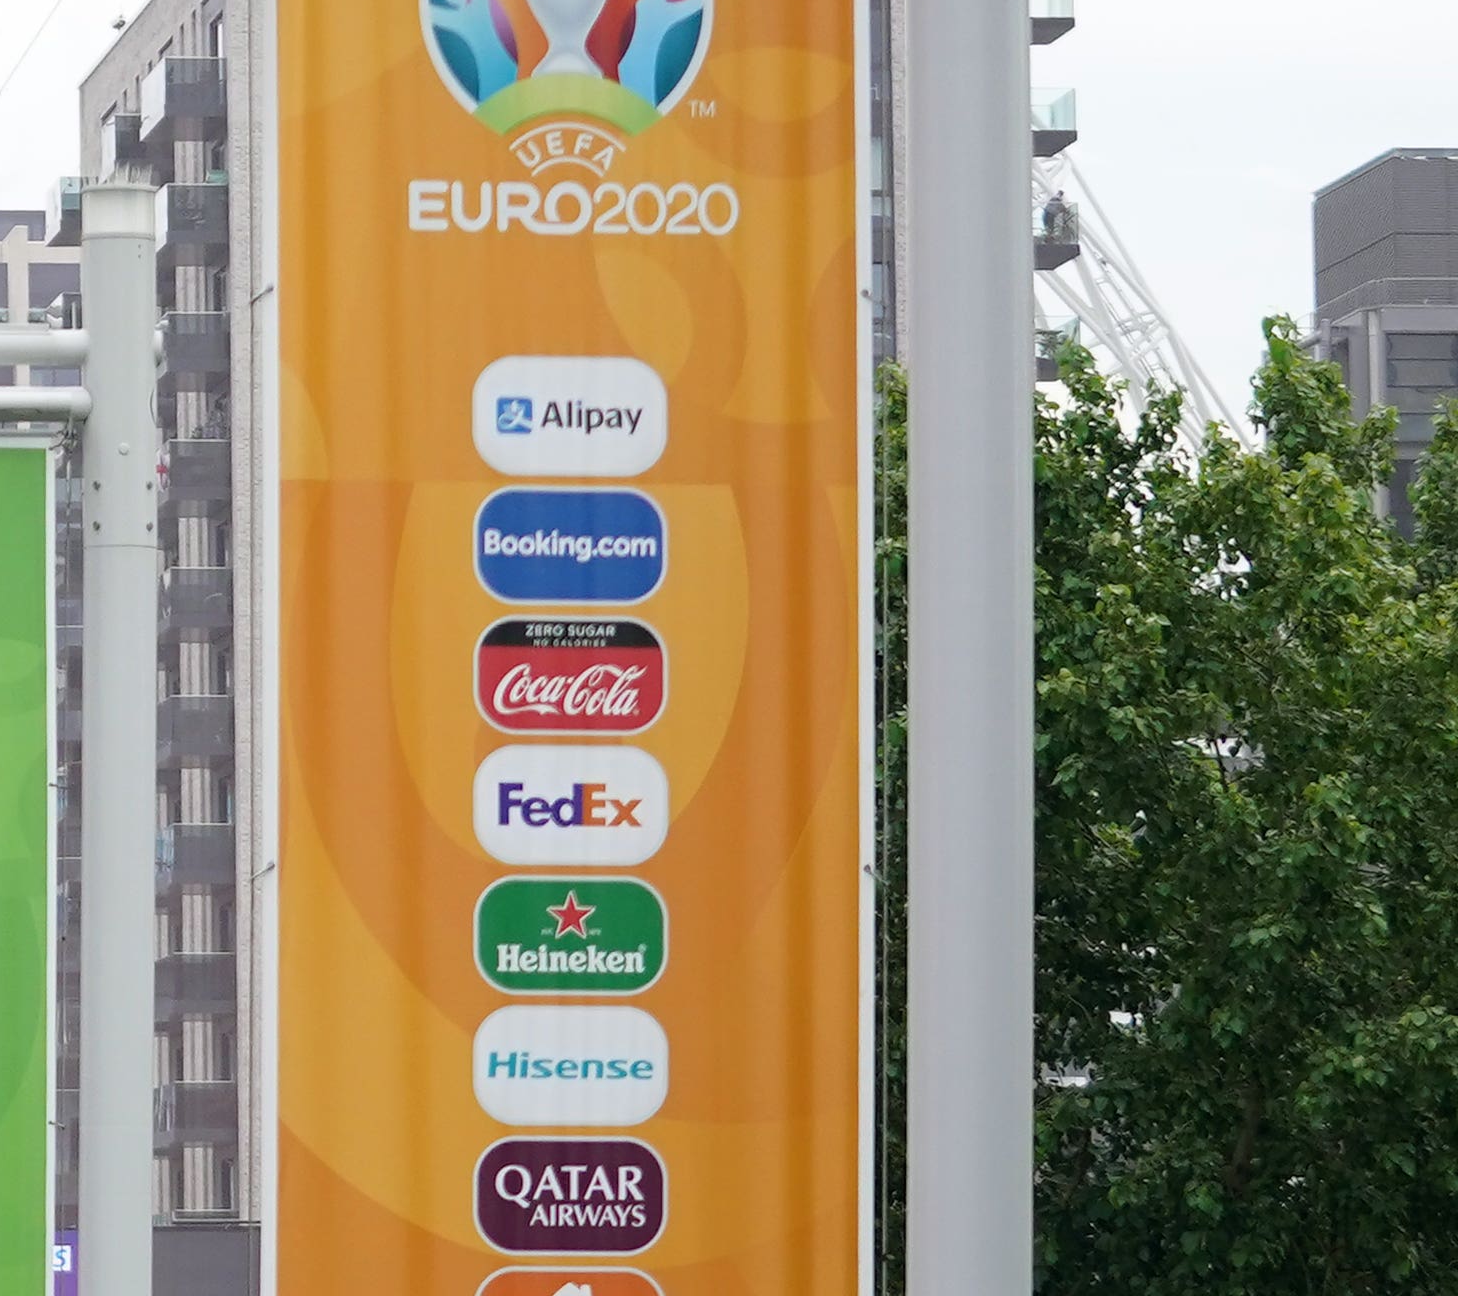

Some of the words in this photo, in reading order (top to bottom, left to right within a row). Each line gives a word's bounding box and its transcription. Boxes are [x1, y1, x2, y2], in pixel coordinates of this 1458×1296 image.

[515, 130, 615, 171] UEFA
[408, 179, 739, 236] EURO2020
[541, 401, 643, 434] Alipay
[484, 530, 657, 562] Booking.com
[525, 624, 564, 636] ZERO
[568, 624, 615, 636] SUGAR
[498, 782, 643, 828] FedEx
[497, 944, 646, 973] Heineken
[488, 1051, 654, 1079] Hisense
[495, 1165, 645, 1208] QATAR
[529, 1205, 646, 1227] AIRWAYS
